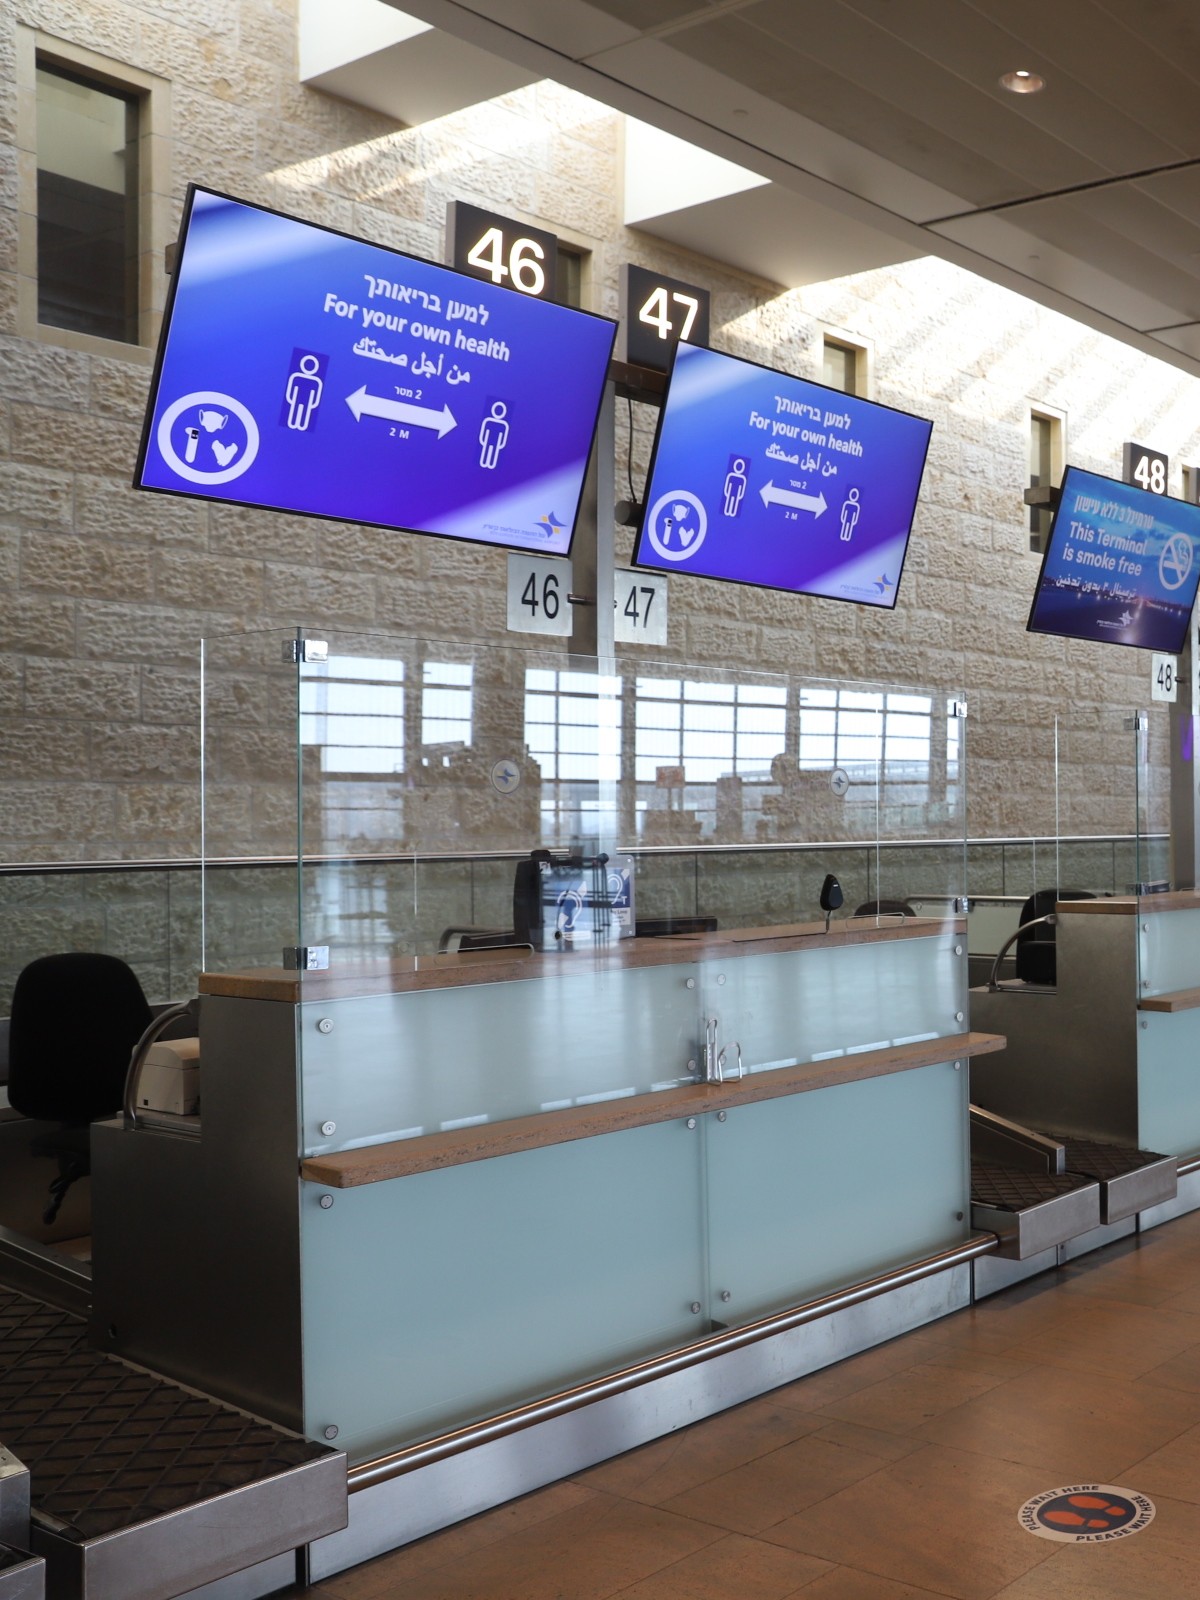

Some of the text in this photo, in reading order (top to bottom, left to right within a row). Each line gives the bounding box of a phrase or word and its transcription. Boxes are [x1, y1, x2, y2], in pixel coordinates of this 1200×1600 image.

[468, 227, 545, 295] 46
[364, 274, 490, 326] למען בריאותך
[639, 287, 699, 341] 47
[323, 293, 511, 362] For your own health
[411, 352, 445, 379] أجل
[445, 364, 471, 385] من
[394, 386, 423, 400] 2 מטר
[774, 395, 851, 430] למען בריאותך
[389, 427, 410, 440] 2 M
[749, 411, 863, 457] For your own health
[821, 460, 838, 477] من
[1134, 456, 1165, 494] 48
[1069, 520, 1147, 556] This Terminal
[1062, 542, 1142, 576] is smoke free
[521, 572, 559, 619] 46
[624, 586, 655, 628] 47
[1157, 663, 1172, 692] 48
[1022, 1485, 1099, 1531] PLEASE WAIT HERE
[1075, 1495, 1153, 1542] PLEASE WAIT HERE
